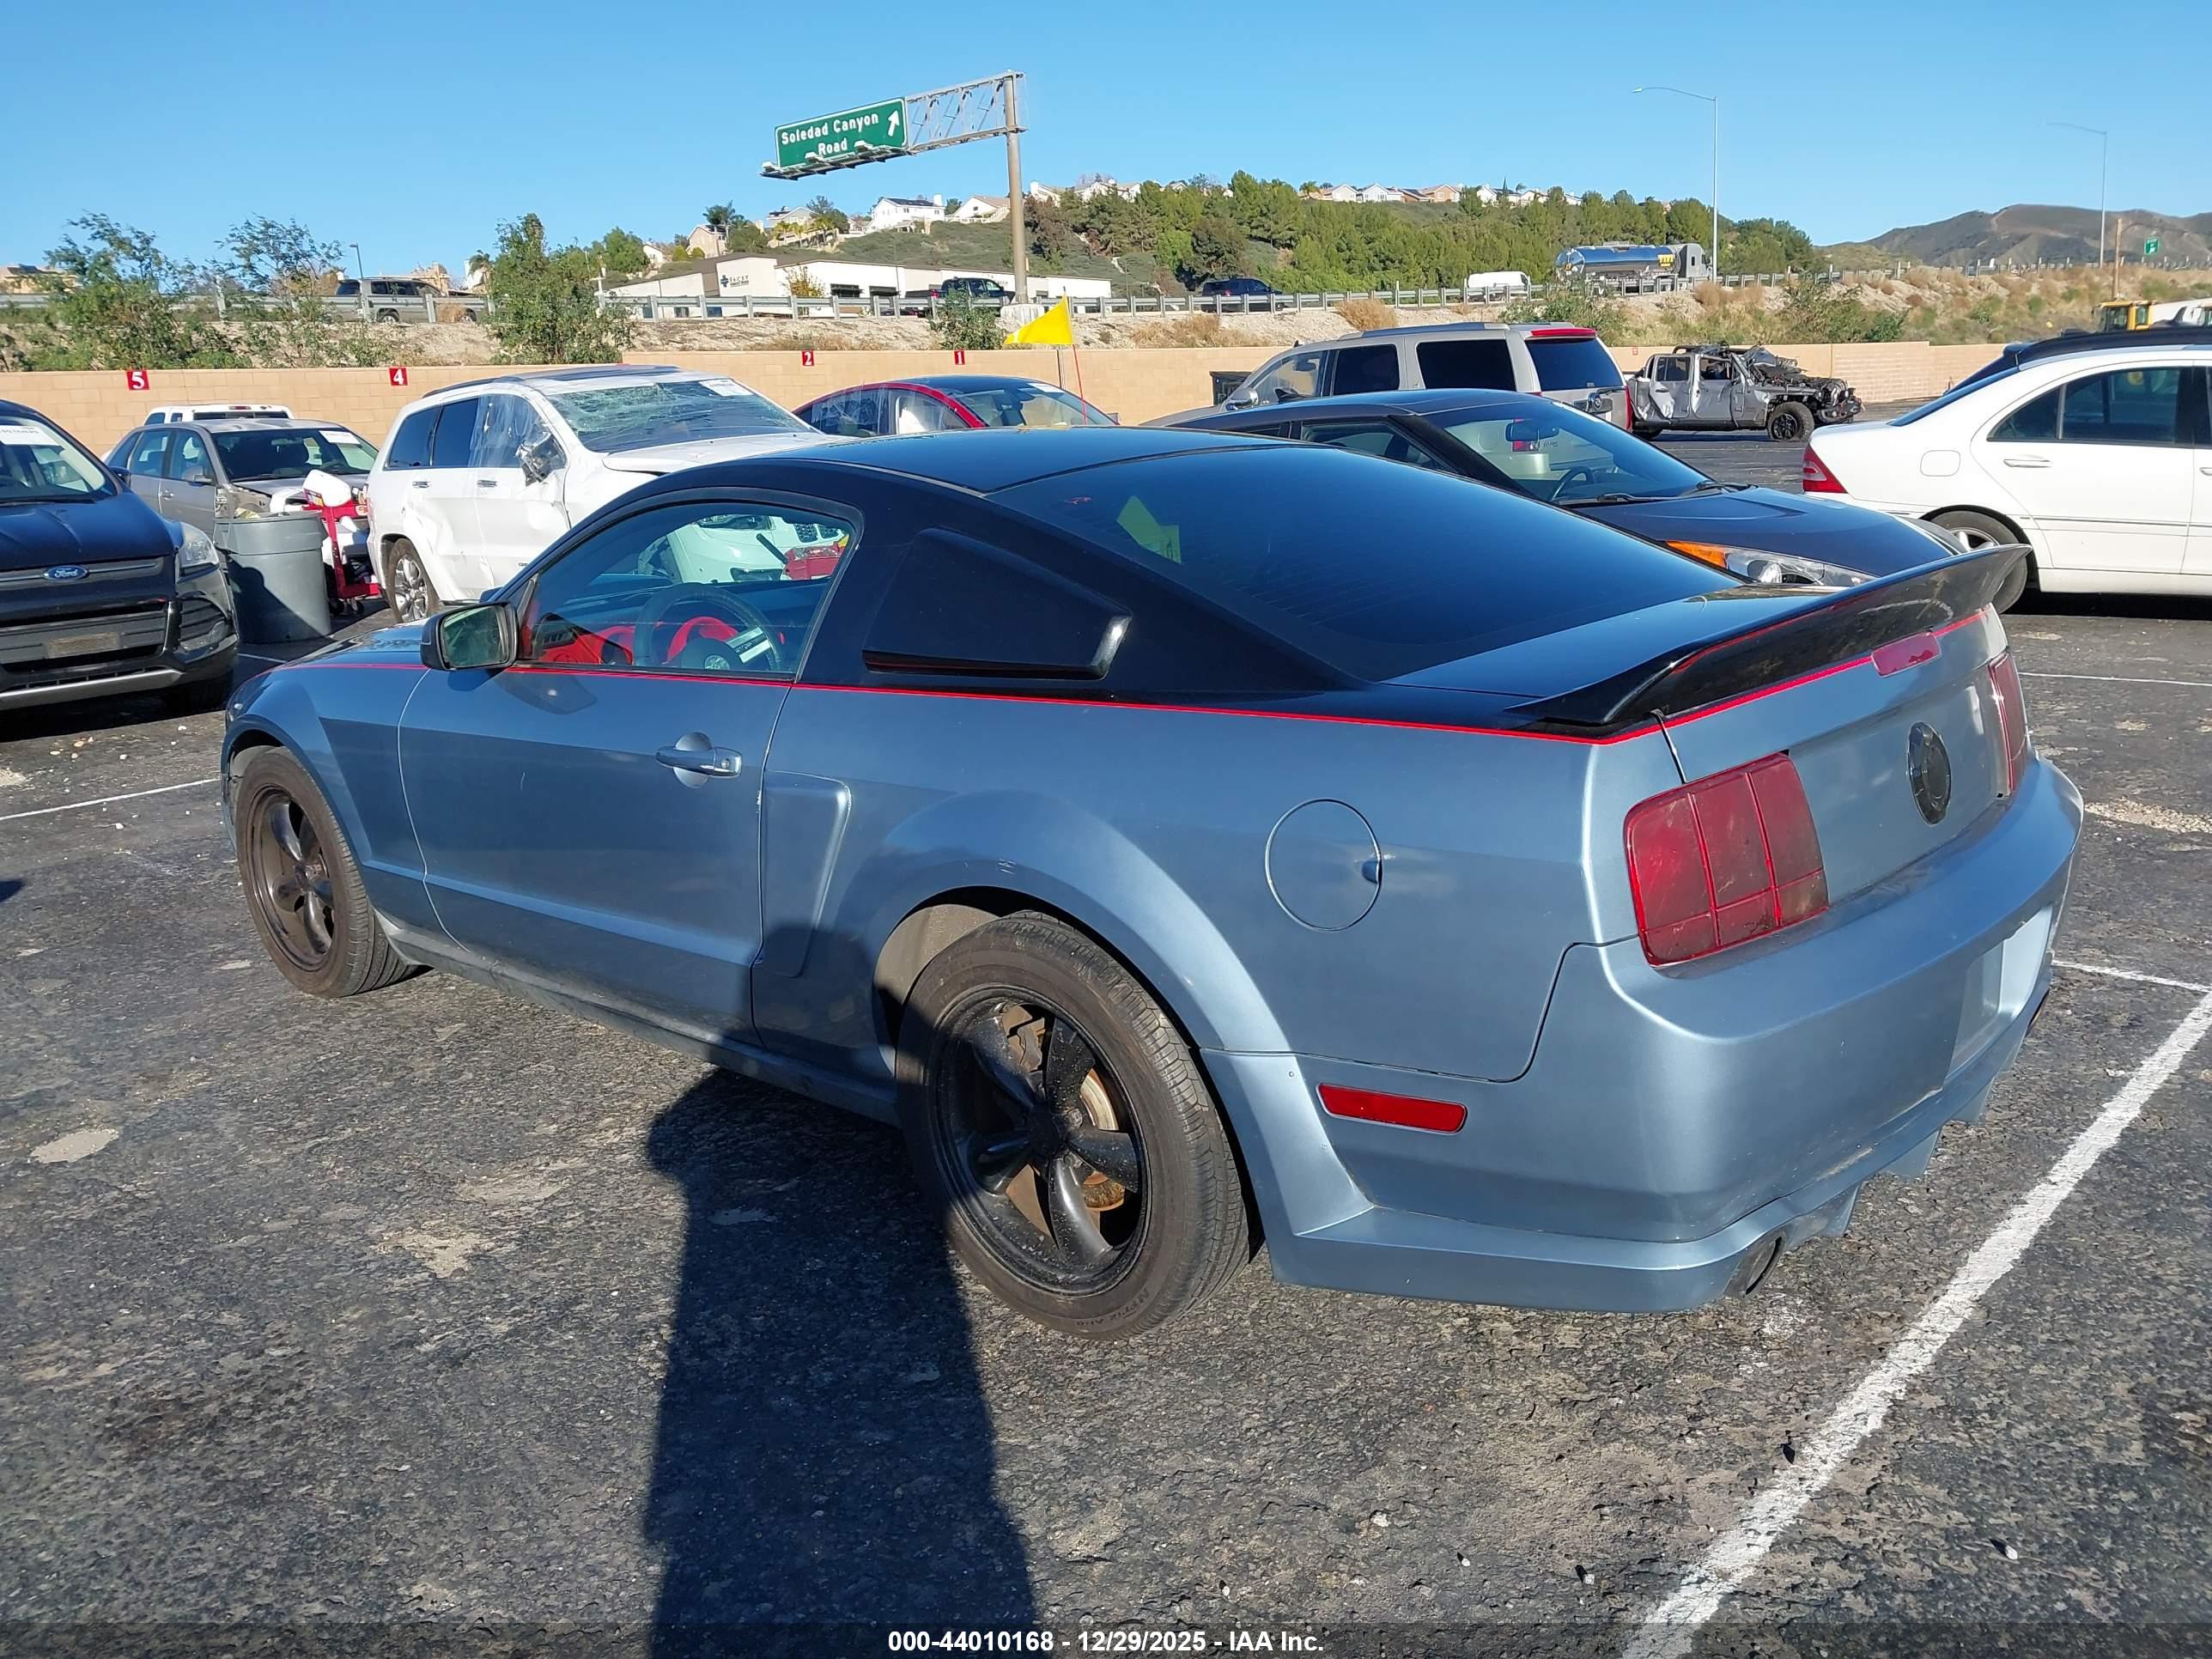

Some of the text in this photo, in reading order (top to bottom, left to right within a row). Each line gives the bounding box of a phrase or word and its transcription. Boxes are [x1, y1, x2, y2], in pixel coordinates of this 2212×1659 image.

[781, 113, 879, 145] Soledad Canyon
[817, 137, 848, 155] Road
[804, 351, 812, 366] 2
[957, 351, 963, 365] 1
[131, 370, 145, 389] 5
[392, 368, 404, 386] 4
[54, 568, 78, 578] Ford
